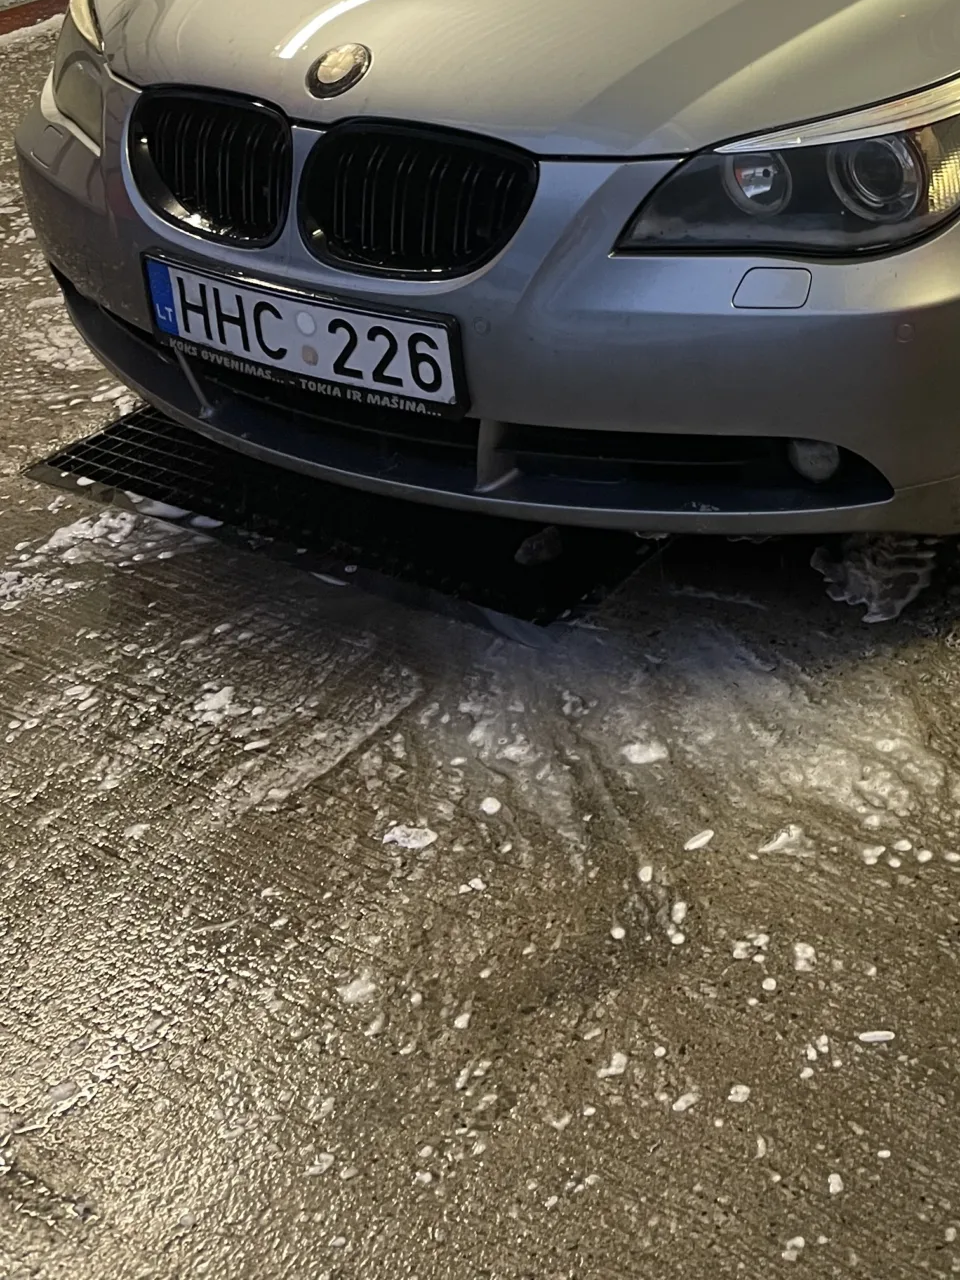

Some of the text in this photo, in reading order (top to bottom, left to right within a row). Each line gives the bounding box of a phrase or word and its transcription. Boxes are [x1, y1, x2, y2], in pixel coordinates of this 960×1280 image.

[155, 303, 174, 323] LT
[175, 276, 443, 393] HHC 226
[299, 378, 342, 399] TOKIA
[346, 389, 363, 404] IR
